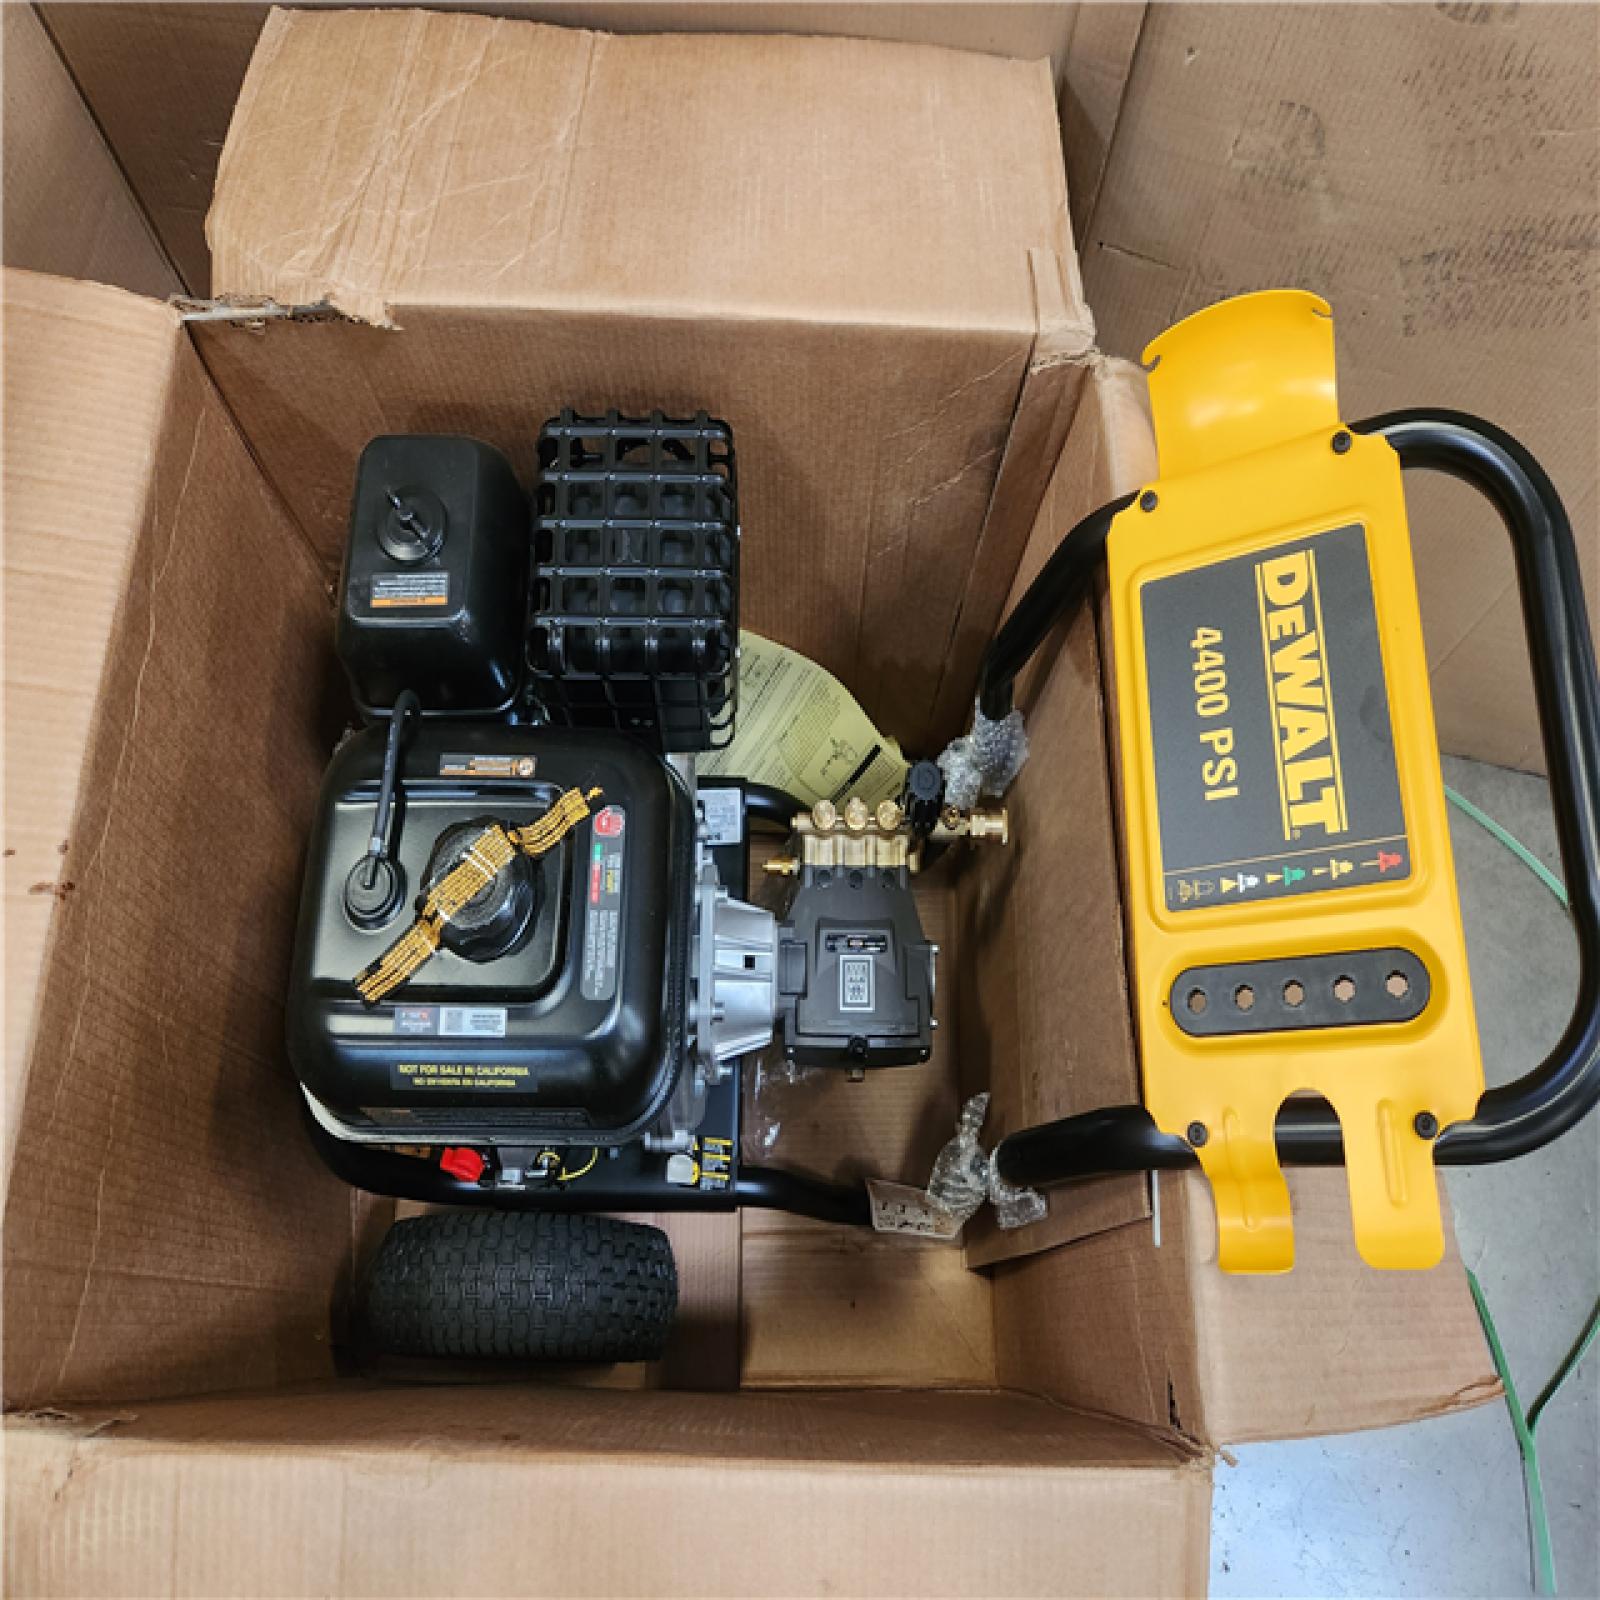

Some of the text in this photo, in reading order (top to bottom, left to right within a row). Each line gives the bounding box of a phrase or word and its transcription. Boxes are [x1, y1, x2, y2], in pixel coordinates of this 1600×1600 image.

[1189, 626, 1240, 801] 4400 PSI
[399, 1064, 529, 1076] NOT FOR SALE IN CALIFORNIA
